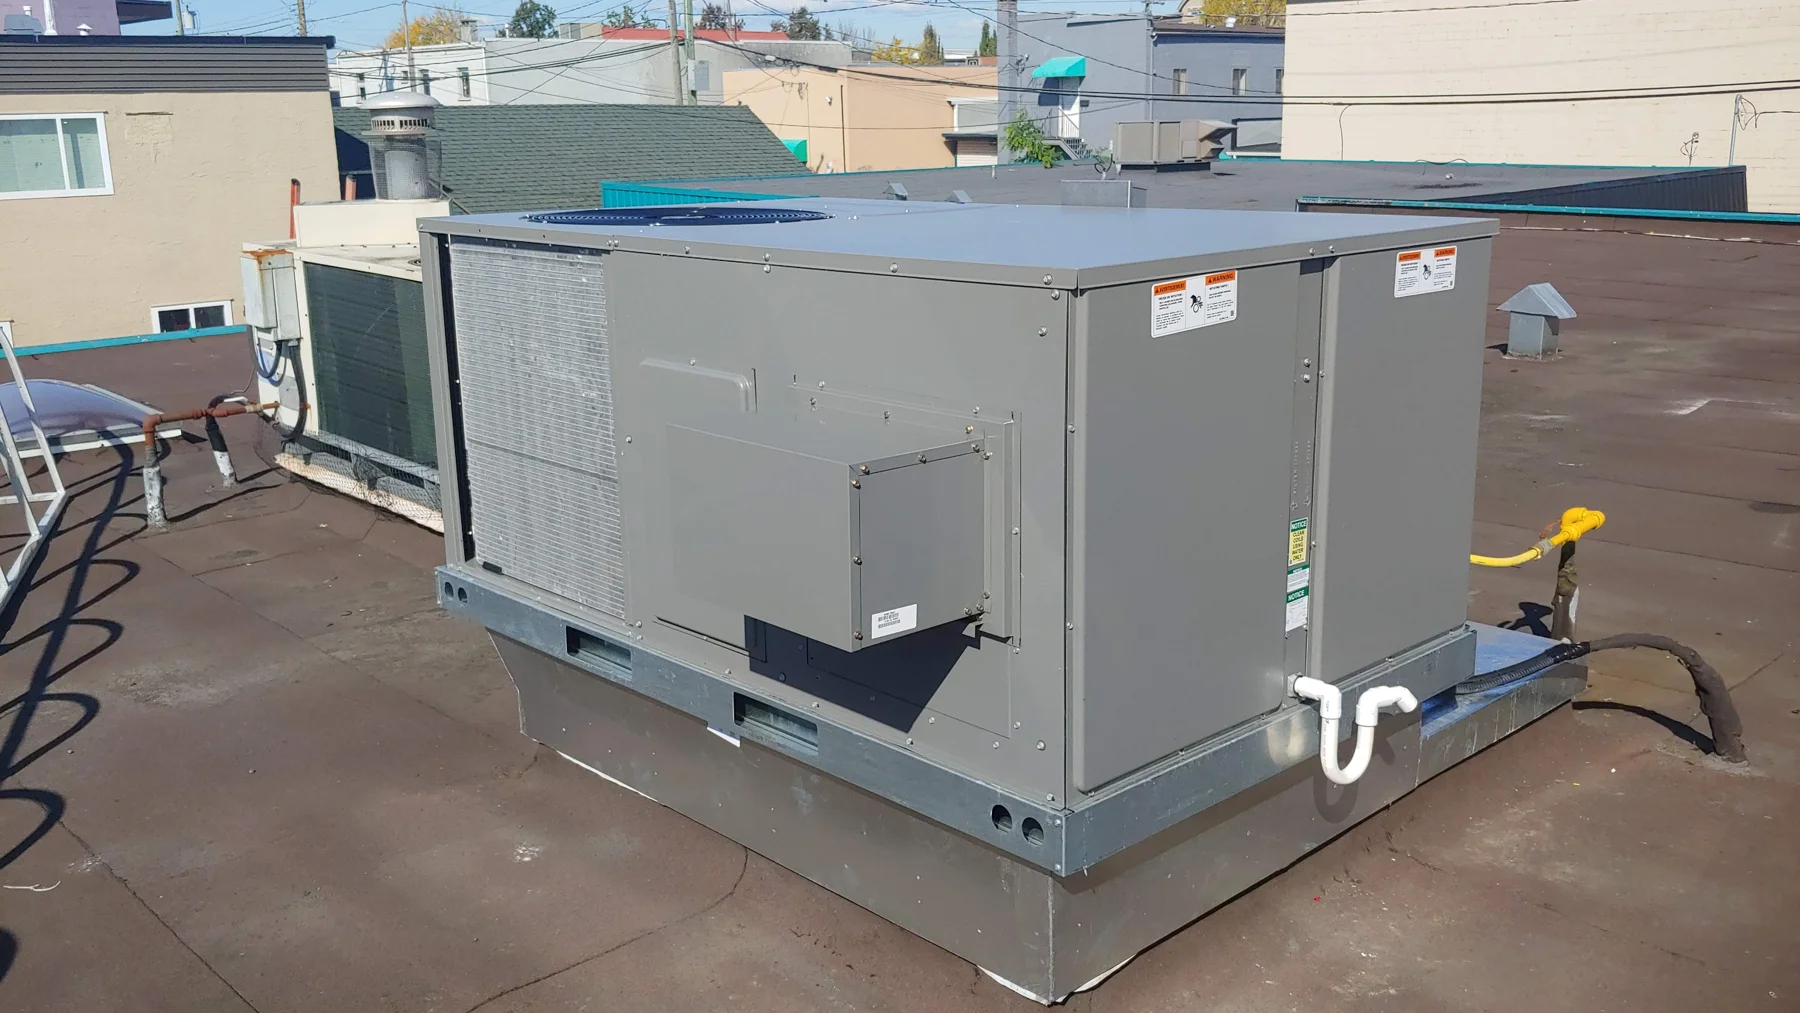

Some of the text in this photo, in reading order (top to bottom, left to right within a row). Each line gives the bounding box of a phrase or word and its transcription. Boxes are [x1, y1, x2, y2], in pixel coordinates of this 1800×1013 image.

[1212, 273, 1233, 282] WARNING
[1291, 520, 1307, 529] NOTICE
[1288, 589, 1305, 601] NOTICE
